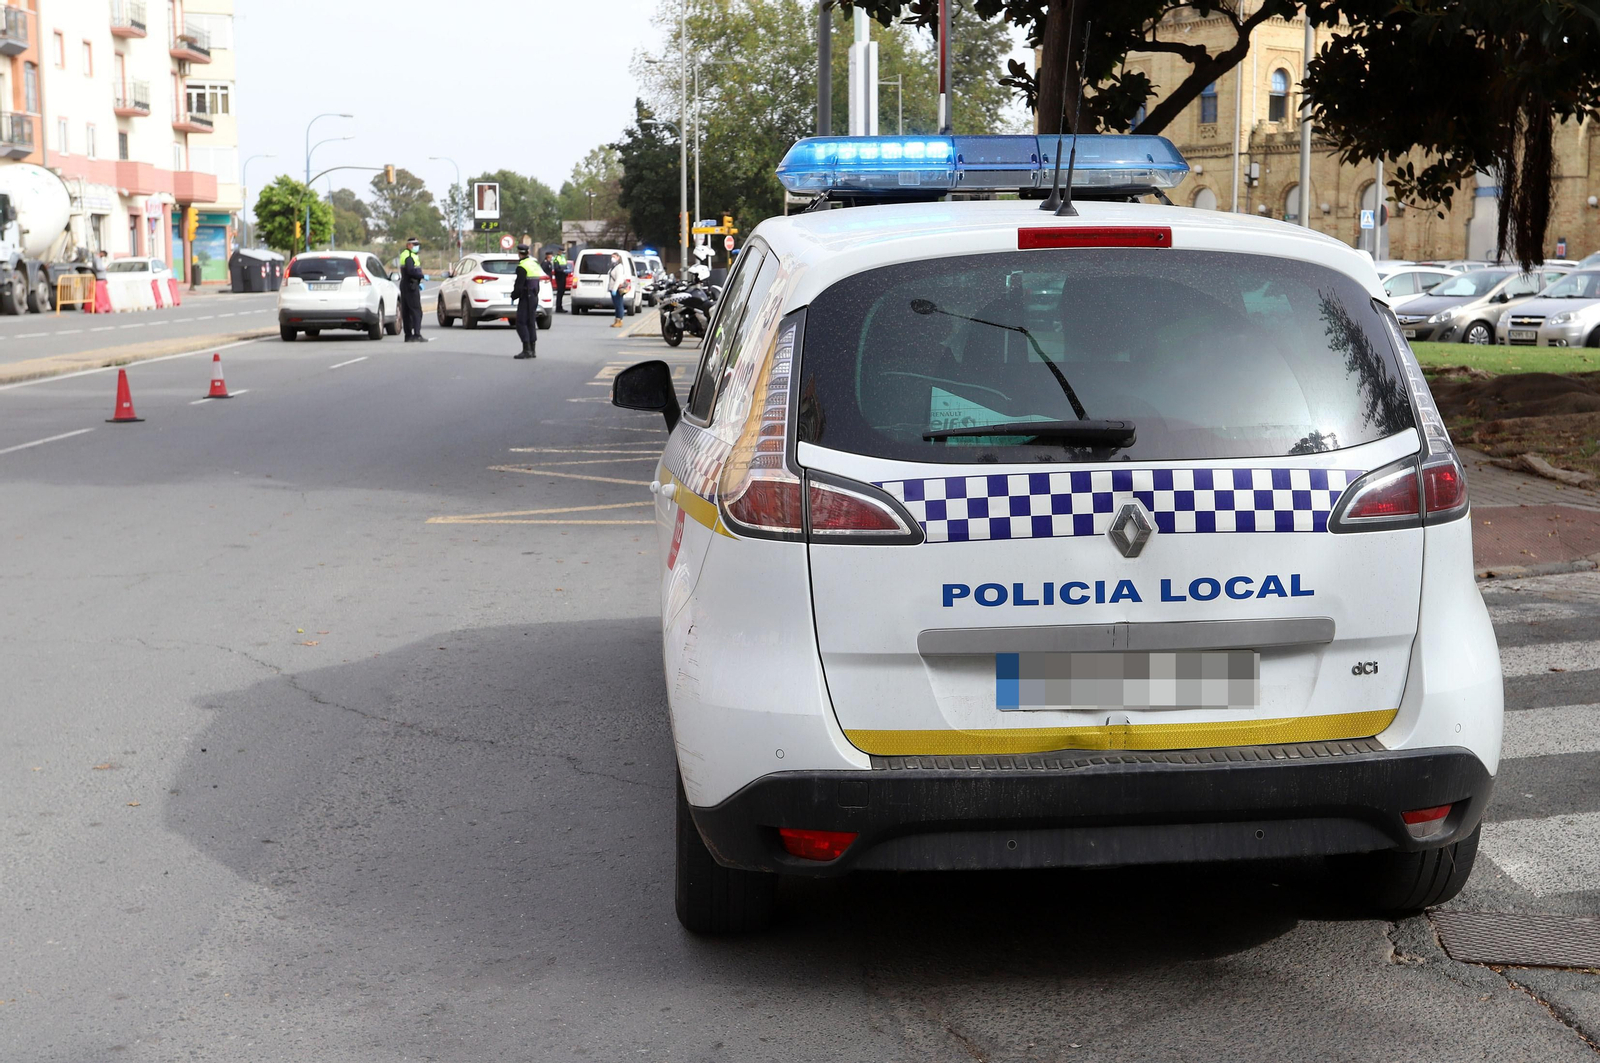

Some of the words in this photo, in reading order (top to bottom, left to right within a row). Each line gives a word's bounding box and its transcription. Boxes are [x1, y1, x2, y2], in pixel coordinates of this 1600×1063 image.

[930, 417, 959, 431] elf
[941, 579, 1144, 608] POLICIA
[1159, 573, 1315, 602] LOCAL
[1351, 660, 1379, 676] dCi
